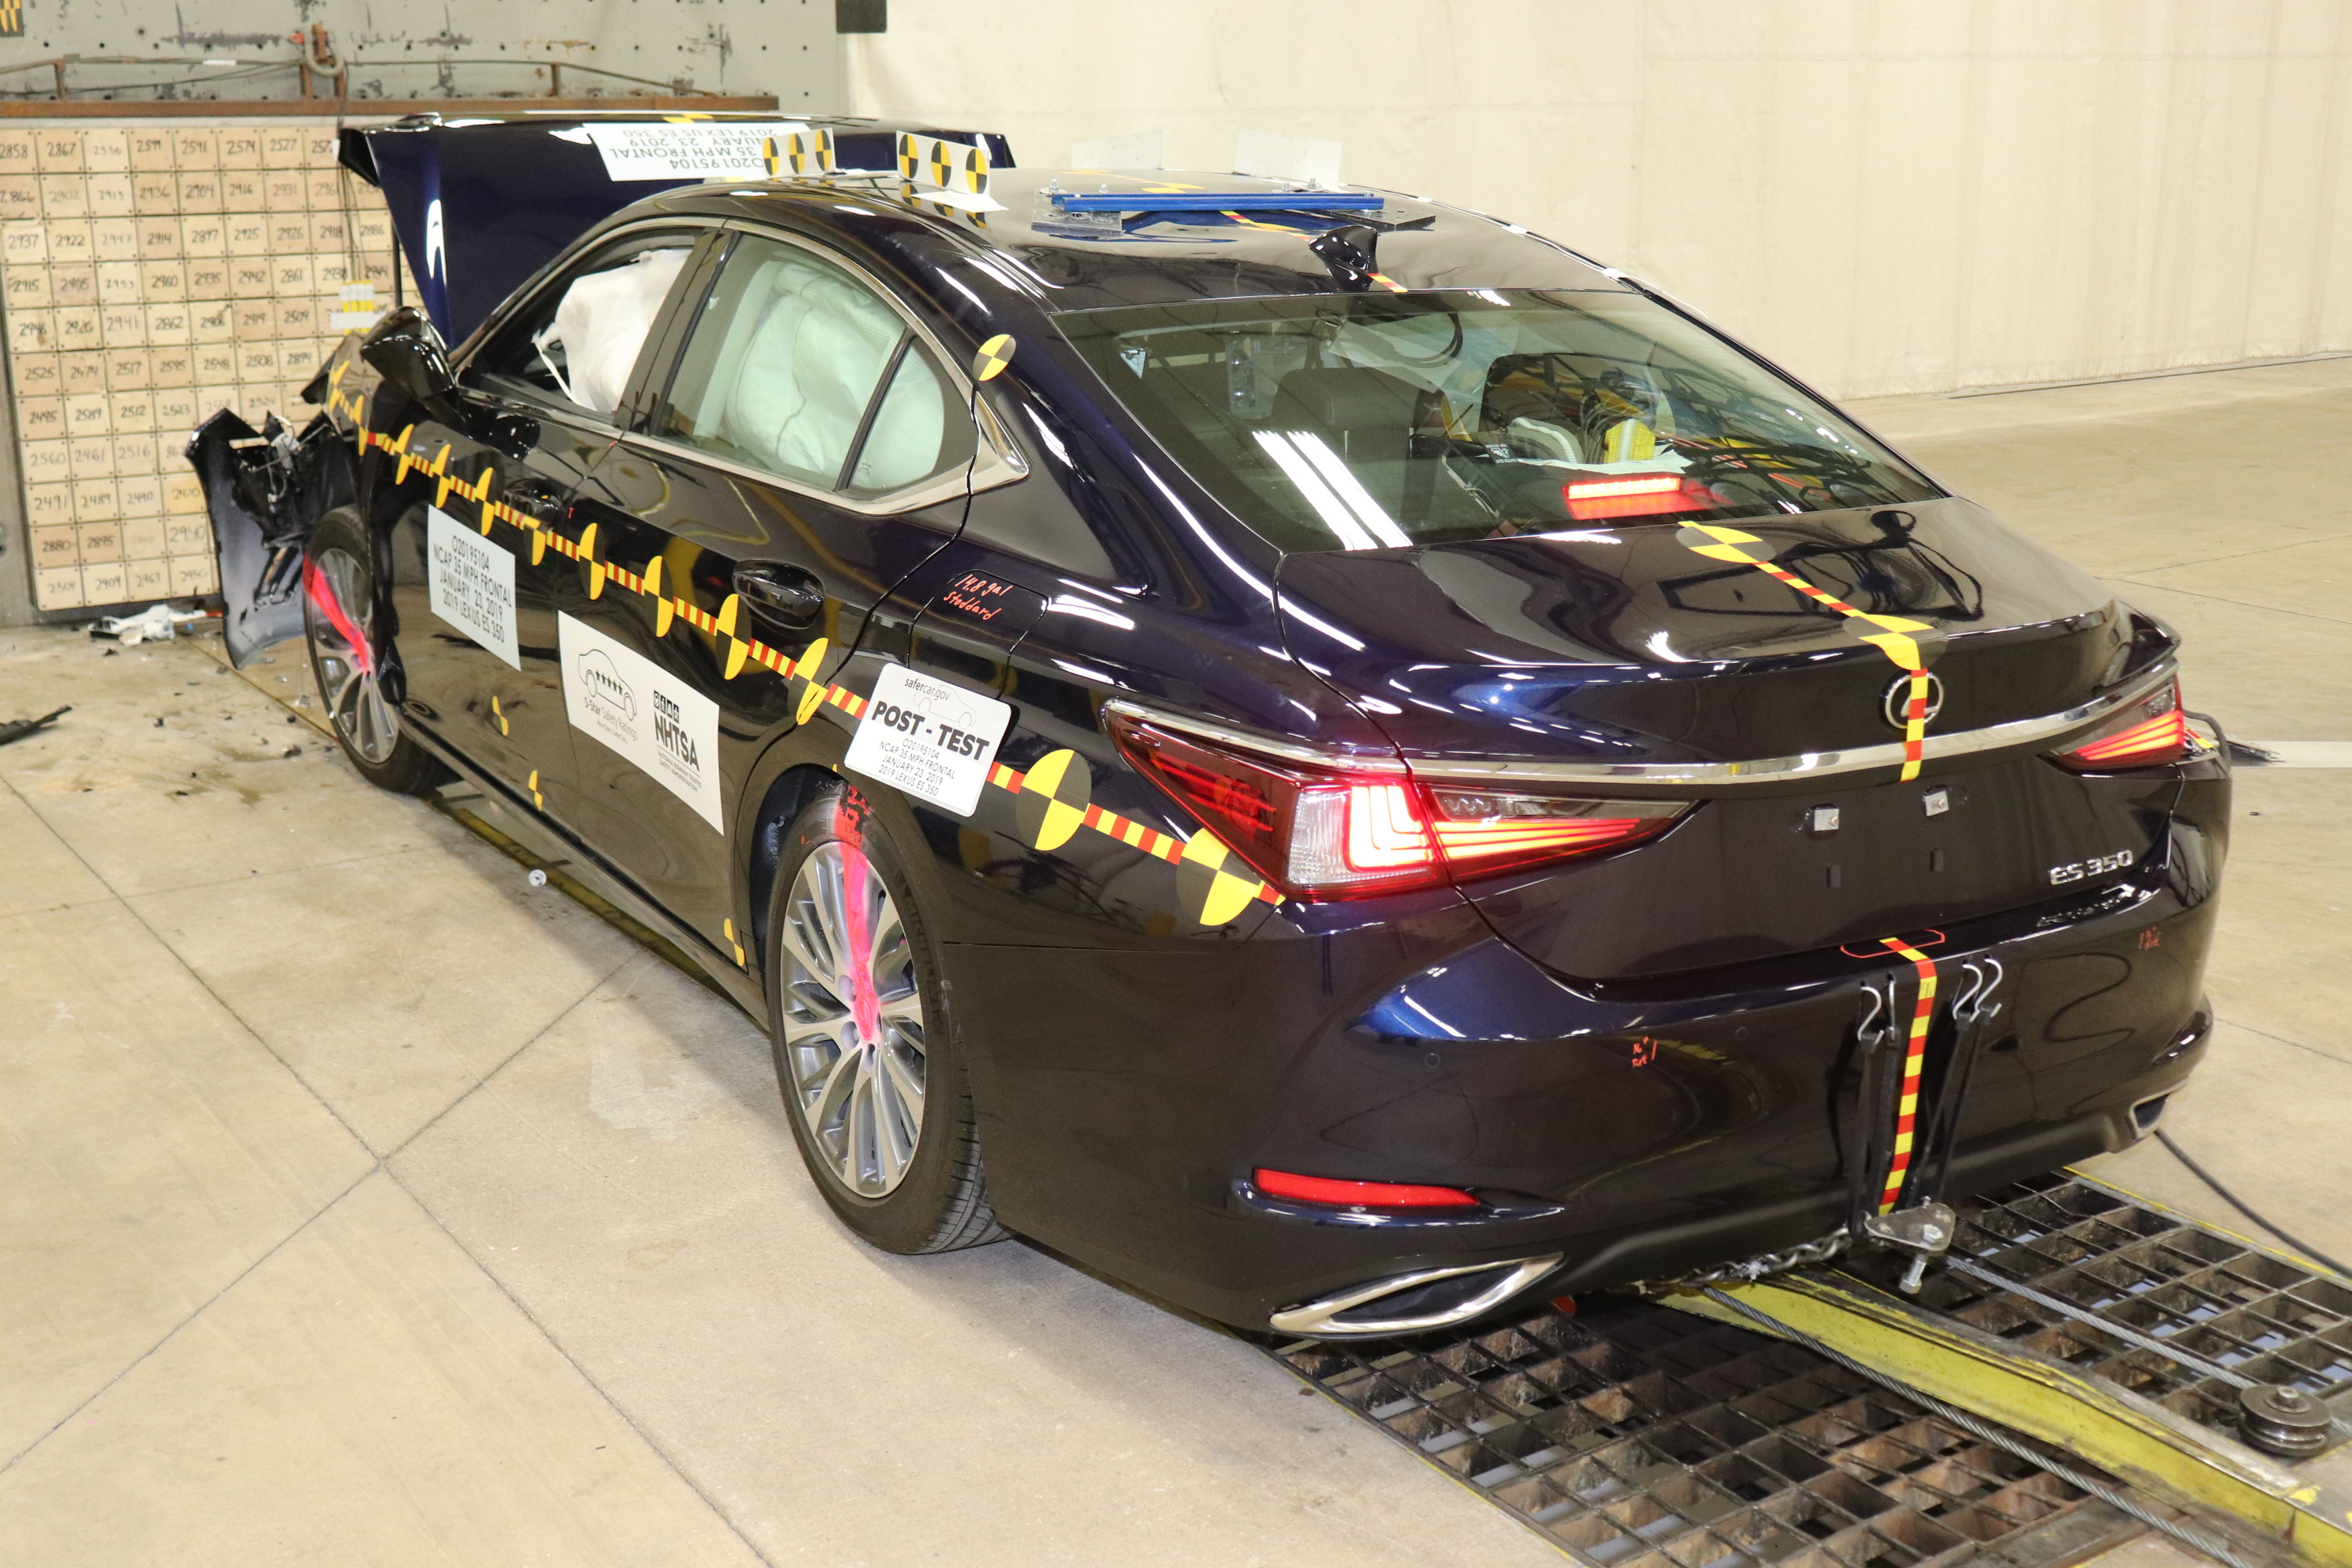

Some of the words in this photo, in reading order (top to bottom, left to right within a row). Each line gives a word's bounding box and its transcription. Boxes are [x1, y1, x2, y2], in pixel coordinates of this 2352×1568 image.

[0, 144, 28, 159] 2858
[47, 142, 76, 156] 2867
[227, 140, 255, 154] 2574
[270, 139, 296, 152] 2527
[693, 147, 731, 156] MPH
[737, 147, 756, 156] 35
[610, 148, 689, 158] FRONTAL
[140, 188, 170, 199] 2936
[186, 183, 214, 198] 2904
[230, 183, 252, 196] 2916
[273, 184, 296, 196] 2931
[277, 227, 303, 240] 2926
[360, 224, 384, 236] 2886
[8, 235, 39, 250] 2937
[55, 235, 85, 247] 2922
[148, 233, 172, 245] 2914
[195, 272, 222, 285] 2935
[239, 270, 266, 284] 2942
[281, 268, 303, 283] 2861
[107, 316, 138, 331] 2941
[155, 316, 183, 330] 2862
[284, 311, 309, 323] 2509
[25, 368, 55, 380] 2525
[116, 361, 141, 375] 2517
[75, 409, 102, 421] 2589
[121, 405, 146, 418] 2512
[31, 453, 66, 467] 2560
[75, 447, 104, 462] 2461
[119, 446, 150, 460] 2516
[35, 494, 68, 511] 2491
[80, 494, 110, 508] 2489
[127, 492, 153, 504] 2490
[43, 540, 71, 552] 2880
[87, 535, 115, 549] 2895
[452, 535, 489, 572] O20195104
[434, 543, 452, 565] NCAP
[454, 557, 462, 575] 35
[463, 563, 479, 585] MPH
[481, 574, 512, 608] FRONTAL
[96, 579, 120, 590] 2909
[982, 582, 1013, 596] gal
[440, 567, 469, 600] JANUARY
[486, 597, 503, 621] 2019
[443, 588, 458, 610] 2019
[460, 601, 481, 628] LEXUS
[482, 613, 490, 633] ES
[492, 620, 504, 643] 350
[904, 678, 950, 701] safercar.gov
[584, 696, 601, 715] 5-Star
[601, 707, 617, 729] Safety
[618, 717, 638, 741] Ratings
[871, 701, 925, 736] POST
[937, 724, 989, 760] TEST
[654, 710, 700, 771] NHTSA
[903, 738, 940, 760] O20195104
[880, 741, 899, 755] NCAP
[899, 749, 907, 759] 35
[908, 754, 924, 766] MPH
[925, 760, 955, 779] FRONTAL
[883, 755, 914, 774] JANUARY
[915, 768, 924, 779] 23,
[926, 773, 944, 785] 2019
[879, 765, 895, 778] 2019
[895, 771, 915, 786] LEXUS
[916, 781, 924, 790] ES
[925, 785, 939, 797] 350
[2049, 863, 2083, 886] ES
[2086, 849, 2133, 876] 350
